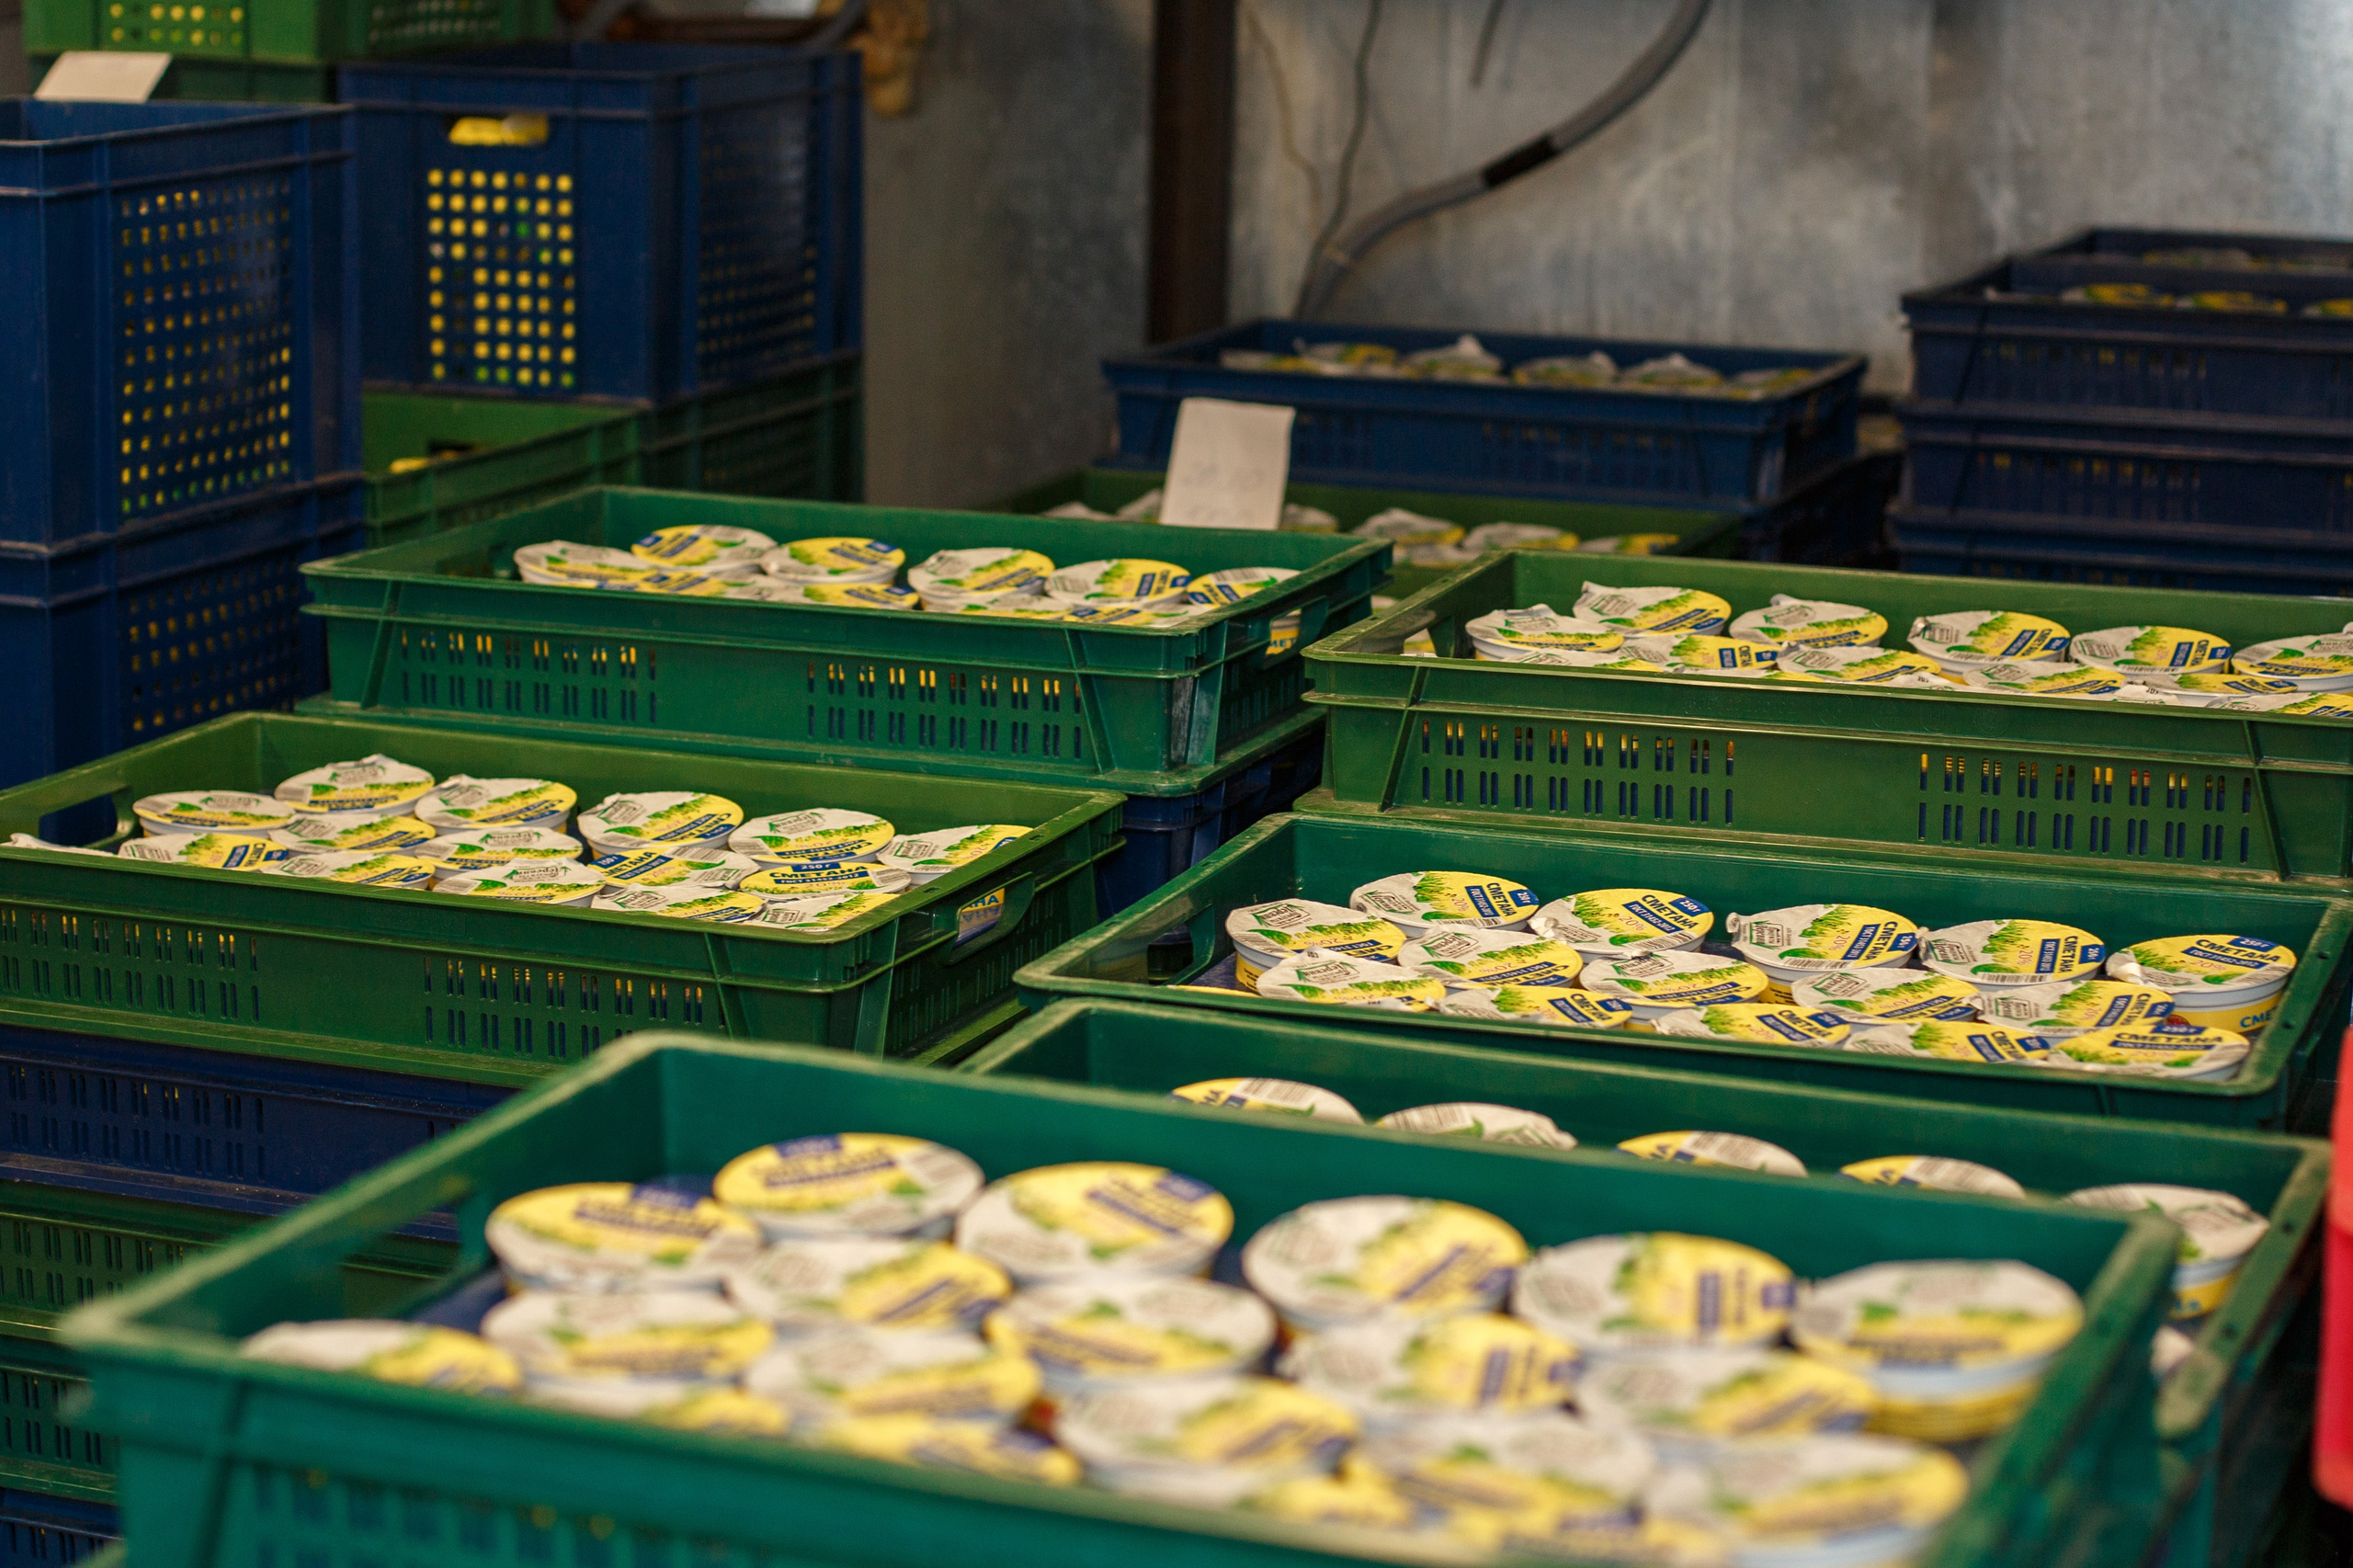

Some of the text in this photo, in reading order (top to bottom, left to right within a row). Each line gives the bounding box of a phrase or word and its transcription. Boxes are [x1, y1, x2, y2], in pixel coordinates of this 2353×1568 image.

[600, 851, 657, 876] МЕТАНА
[769, 866, 868, 879] СМЕТАНА
[805, 873, 859, 882] 31452-2012
[1453, 896, 1472, 912] 20%
[1486, 882, 1518, 917] СМЕТАНА
[1679, 900, 1695, 910] 250
[1642, 894, 1699, 929] СМЕТАНА
[1619, 915, 1648, 931] 20%
[1828, 934, 1850, 951] 20%
[1866, 921, 1898, 960] СМЕТАНА
[2240, 937, 2259, 948] 250
[2059, 936, 2077, 973] СМЕТАНА
[2190, 949, 2212, 959] ГОСТ
[2196, 938, 2282, 962] СМЕТАНА
[2191, 959, 2226, 971] 20%
[1483, 965, 1569, 985] СМЕТАНА
[1779, 1010, 1833, 1037] СМЕТАНА
[2240, 1011, 2272, 1028] СМЕ
[2116, 1032, 2224, 1043] СМЕТАНА
